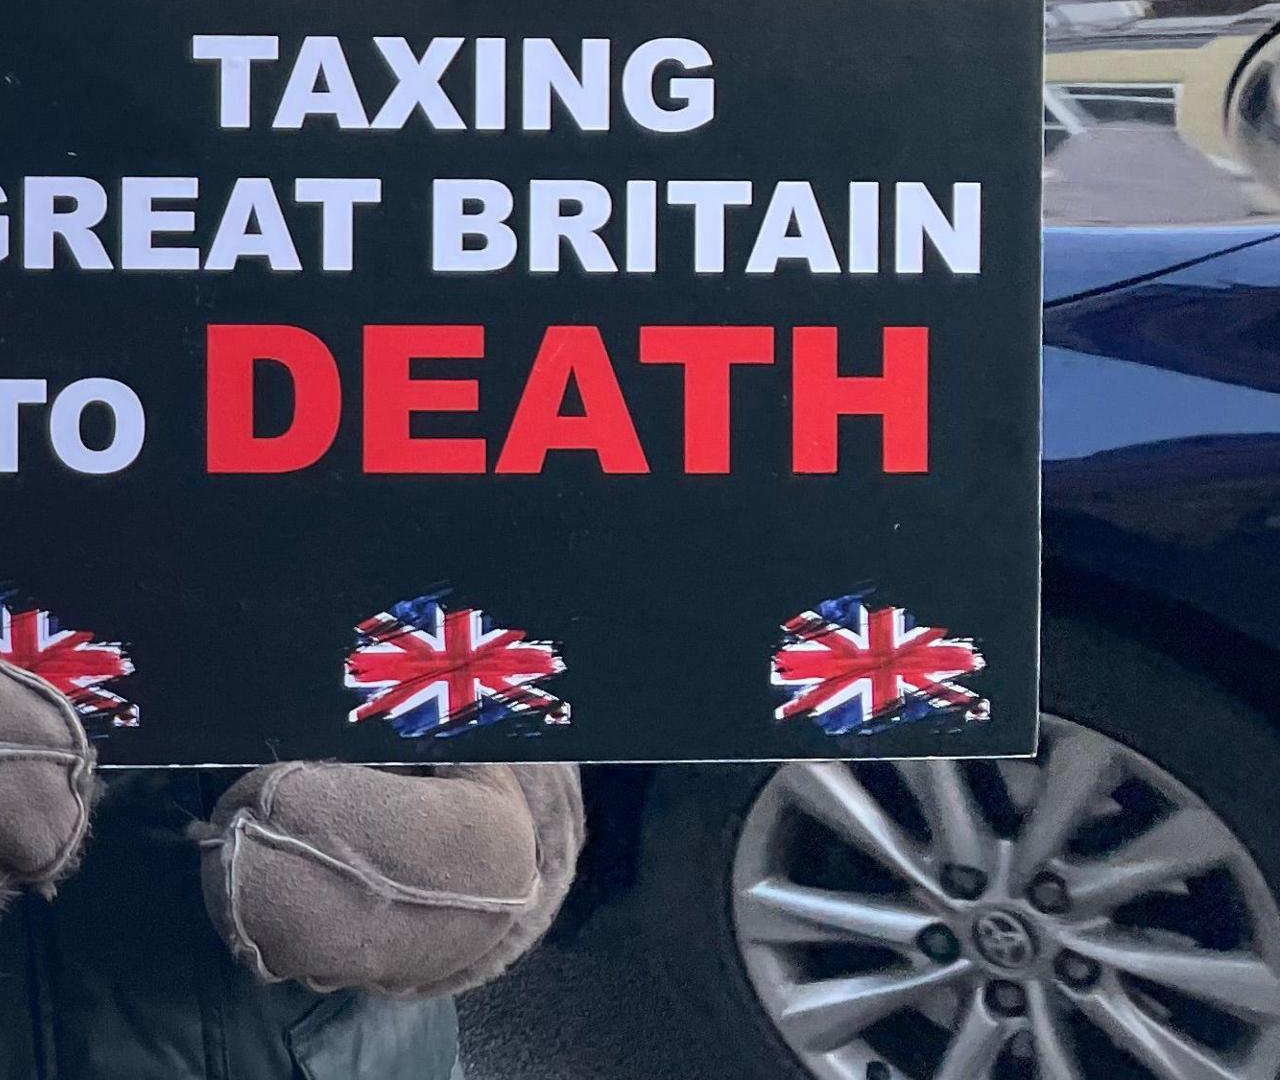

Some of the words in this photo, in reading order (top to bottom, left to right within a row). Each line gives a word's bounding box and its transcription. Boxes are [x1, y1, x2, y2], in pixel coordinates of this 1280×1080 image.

[192, 34, 716, 133] TAXING
[431, 178, 982, 275] BRITAIN
[205, 325, 931, 475] DEATH
